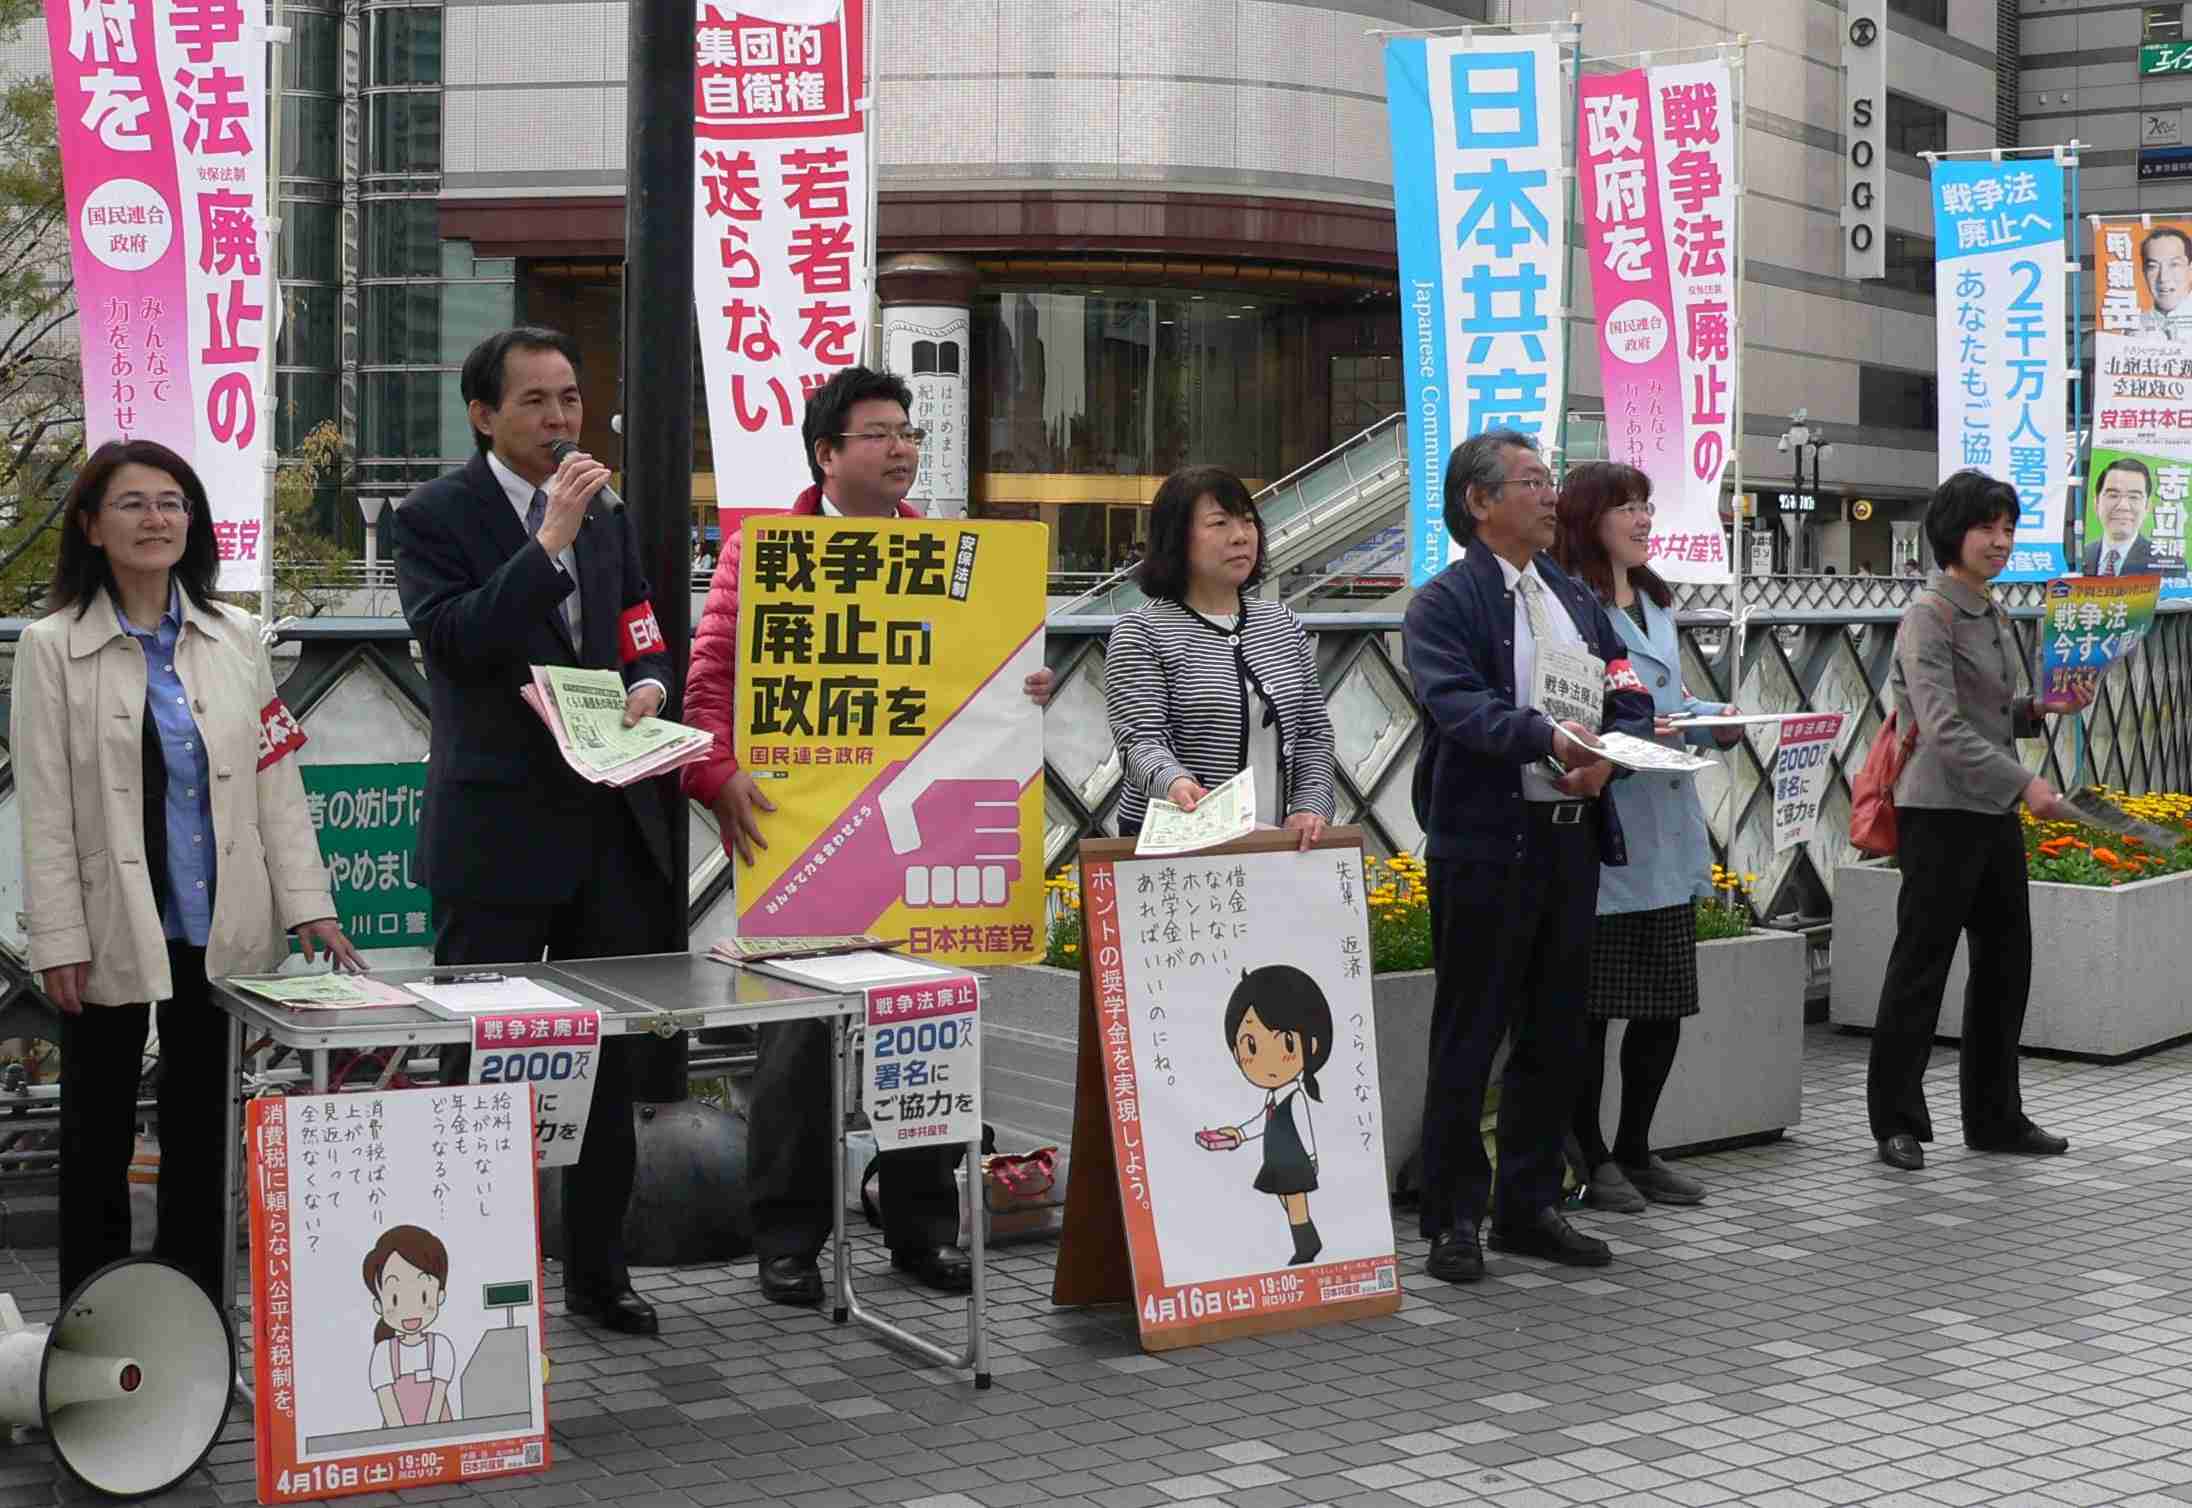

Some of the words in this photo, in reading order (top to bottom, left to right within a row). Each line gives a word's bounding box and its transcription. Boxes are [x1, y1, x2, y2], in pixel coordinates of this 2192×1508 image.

[696, 24, 823, 68] 集団的
[702, 71, 826, 114] 自衛権
[1584, 94, 1653, 283] 政府を
[1851, 98, 1875, 252] SOGO
[1941, 171, 2038, 215] 戦争法
[87, 205, 164, 227] 国民連合
[110, 233, 148, 254] 政府
[1957, 213, 2053, 249] 廃止へ
[700, 149, 794, 433] 送らない
[780, 147, 858, 400] 若者を
[141, 297, 169, 402] みんなで
[1411, 279, 1435, 377] Japanese
[104, 297, 136, 444] 力をあわせ
[2005, 260, 2048, 529] 2千万人署名
[1421, 386, 1441, 508] Communist
[755, 530, 945, 595] 戦争法
[1421, 518, 1445, 577] Party
[751, 603, 930, 664] 廃止の
[2053, 600, 2129, 633] 戦争法
[751, 674, 925, 737] 政府を
[751, 746, 873, 765] 国民連合政府
[1158, 867, 1184, 967] 奨学金が
[1184, 873, 1205, 966] ホントの
[1226, 864, 1247, 939] 借金に
[909, 925, 1034, 954] 日本共産党
[1341, 936, 1361, 978] 返済
[483, 1017, 594, 1040] 戦争法廃止
[875, 985, 975, 1015] 戦争法廃止
[1091, 868, 1150, 1210] ホントの奨学金を実現しよう。
[872, 1090, 973, 1122] ご協力を
[874, 1060, 949, 1090] 署名に
[345, 1105, 363, 1184] 上がって
[450, 1094, 468, 1154] 年金も
[491, 1091, 512, 1152] 給料は
[897, 1123, 949, 1140] 日本共産党
[366, 1100, 386, 1224] 消費税ばかり
[473, 1096, 493, 1216] 上がらないし
[264, 1104, 294, 1418] 消費税に頼らない公平な税制を。
